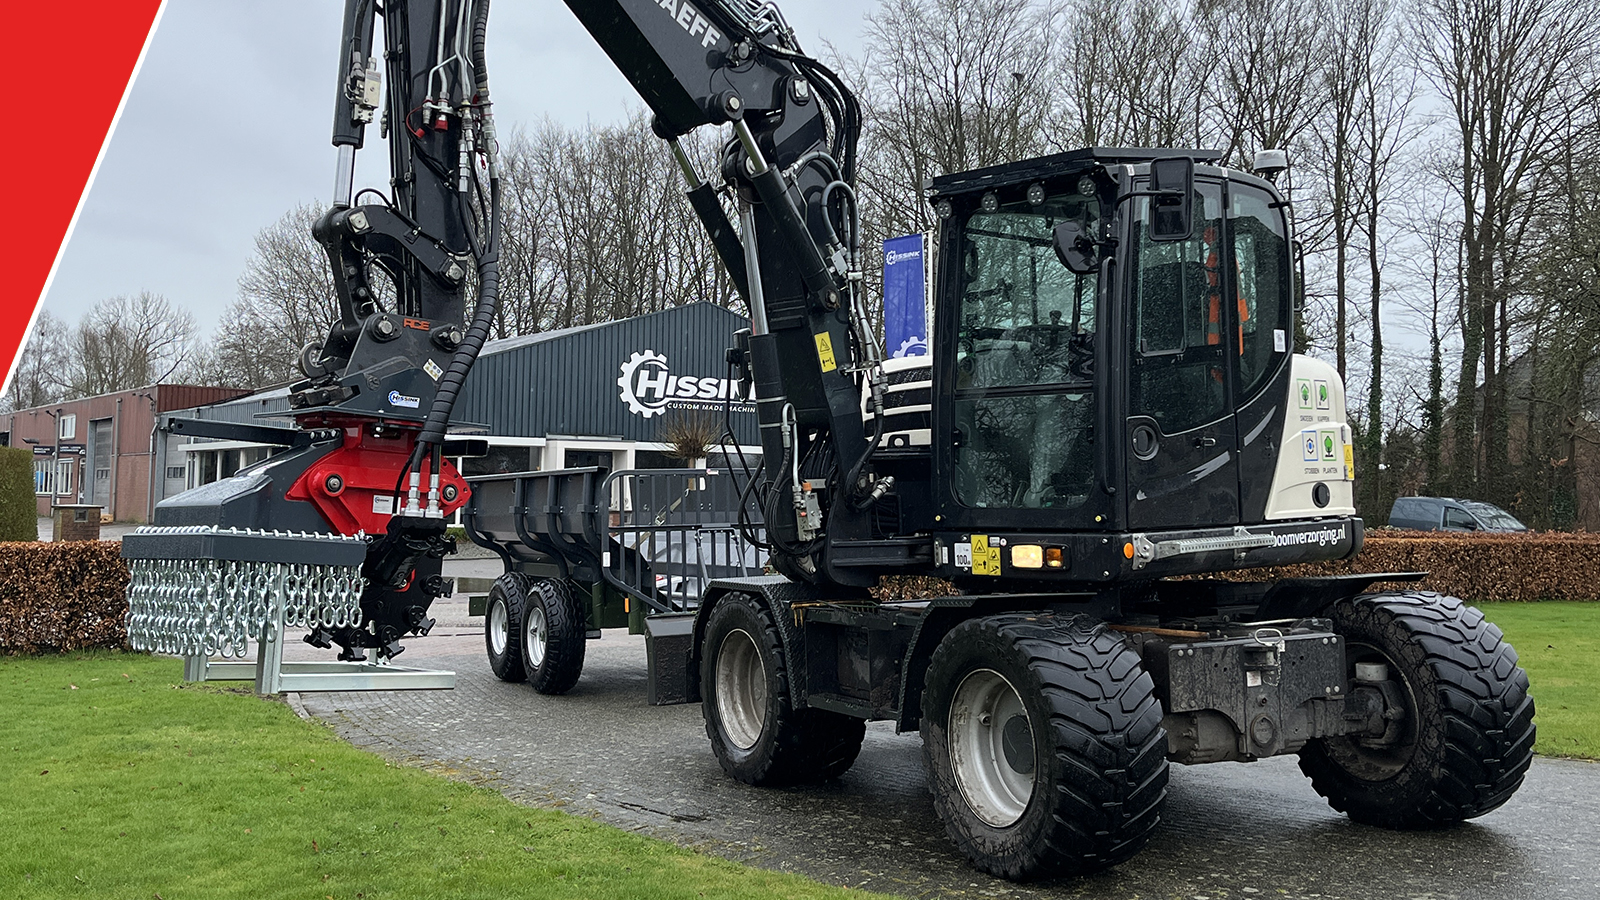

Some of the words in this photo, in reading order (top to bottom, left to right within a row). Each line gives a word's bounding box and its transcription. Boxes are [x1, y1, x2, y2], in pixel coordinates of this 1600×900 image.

[654, 0, 721, 48] AEFF
[889, 250, 920, 260] HISSINK
[667, 402, 700, 410] CUSTOM
